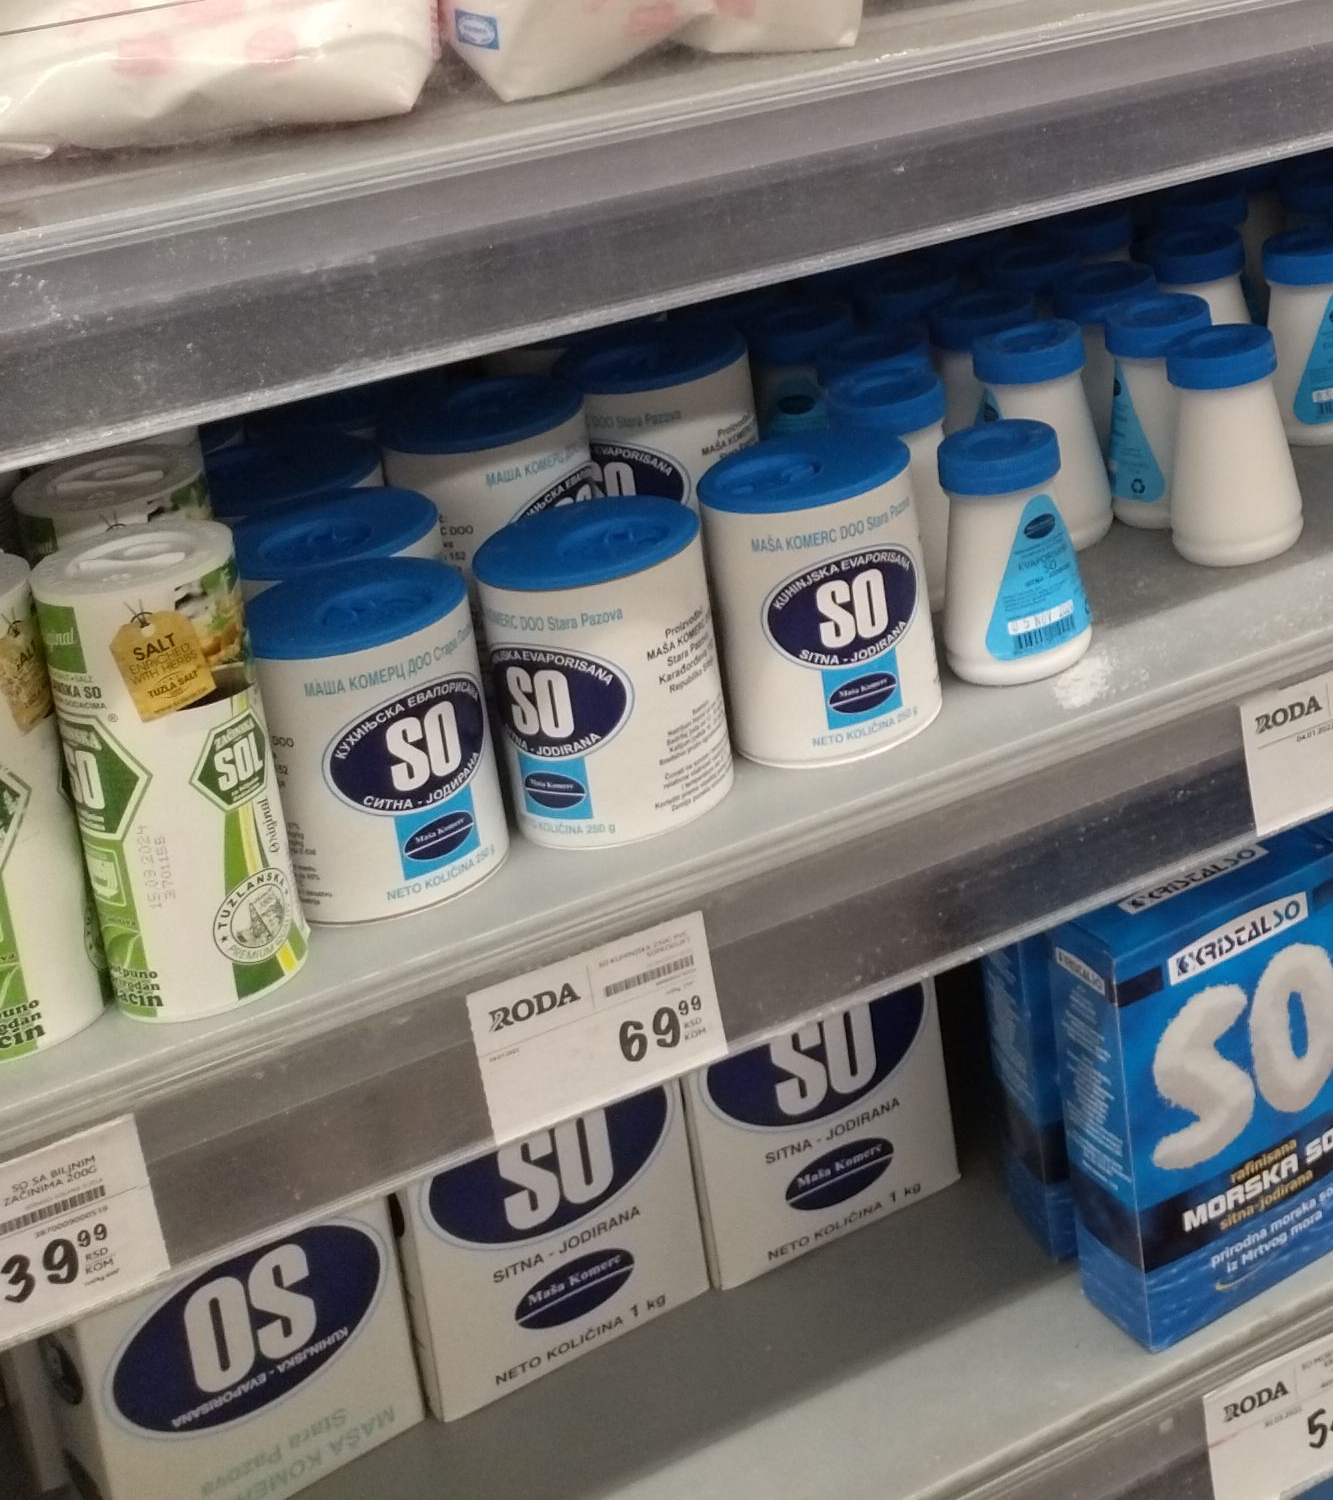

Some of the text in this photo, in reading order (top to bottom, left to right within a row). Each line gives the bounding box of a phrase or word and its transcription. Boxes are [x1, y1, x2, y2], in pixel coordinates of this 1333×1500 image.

[751, 521, 864, 554] MAŠA KOMERC DOO
[520, 606, 623, 631] DOO Stara Pazova
[815, 568, 890, 650] SO
[133, 631, 176, 661] SALT
[800, 620, 907, 665] SITNA JODIRANA
[147, 675, 176, 698] TUZLA
[303, 679, 346, 699] МАША
[349, 665, 405, 694] КОМЕРЦ
[506, 667, 575, 740] SO
[812, 714, 896, 748] NETO KOLIČINA
[1255, 695, 1323, 735] RODA
[384, 700, 460, 793] SO
[536, 732, 602, 757] JODIRANA
[216, 746, 267, 794] SOL
[363, 795, 414, 813] СИТНА
[387, 884, 422, 902] NETO
[489, 983, 581, 1032] RODA
[619, 1006, 681, 1062] 69
[765, 1098, 901, 1165] SITNA JODIRANA
[50, 1155, 96, 1178] BILJNIM
[1230, 1138, 1298, 1183] rafinisana
[1182, 1158, 1301, 1235] MORSKA
[492, 1206, 642, 1284] SITNA JODIRANA
[767, 1200, 884, 1262] NETO KOLIČINA
[1241, 1210, 1323, 1270] Mrtvog mora
[0, 1223, 108, 1303] 39 99
[527, 1253, 622, 1307] Maša Komerc
[183, 1243, 318, 1393] SO
[495, 1293, 667, 1387] NETO KOLIČINA kg
[1224, 1380, 1290, 1424] RODA
